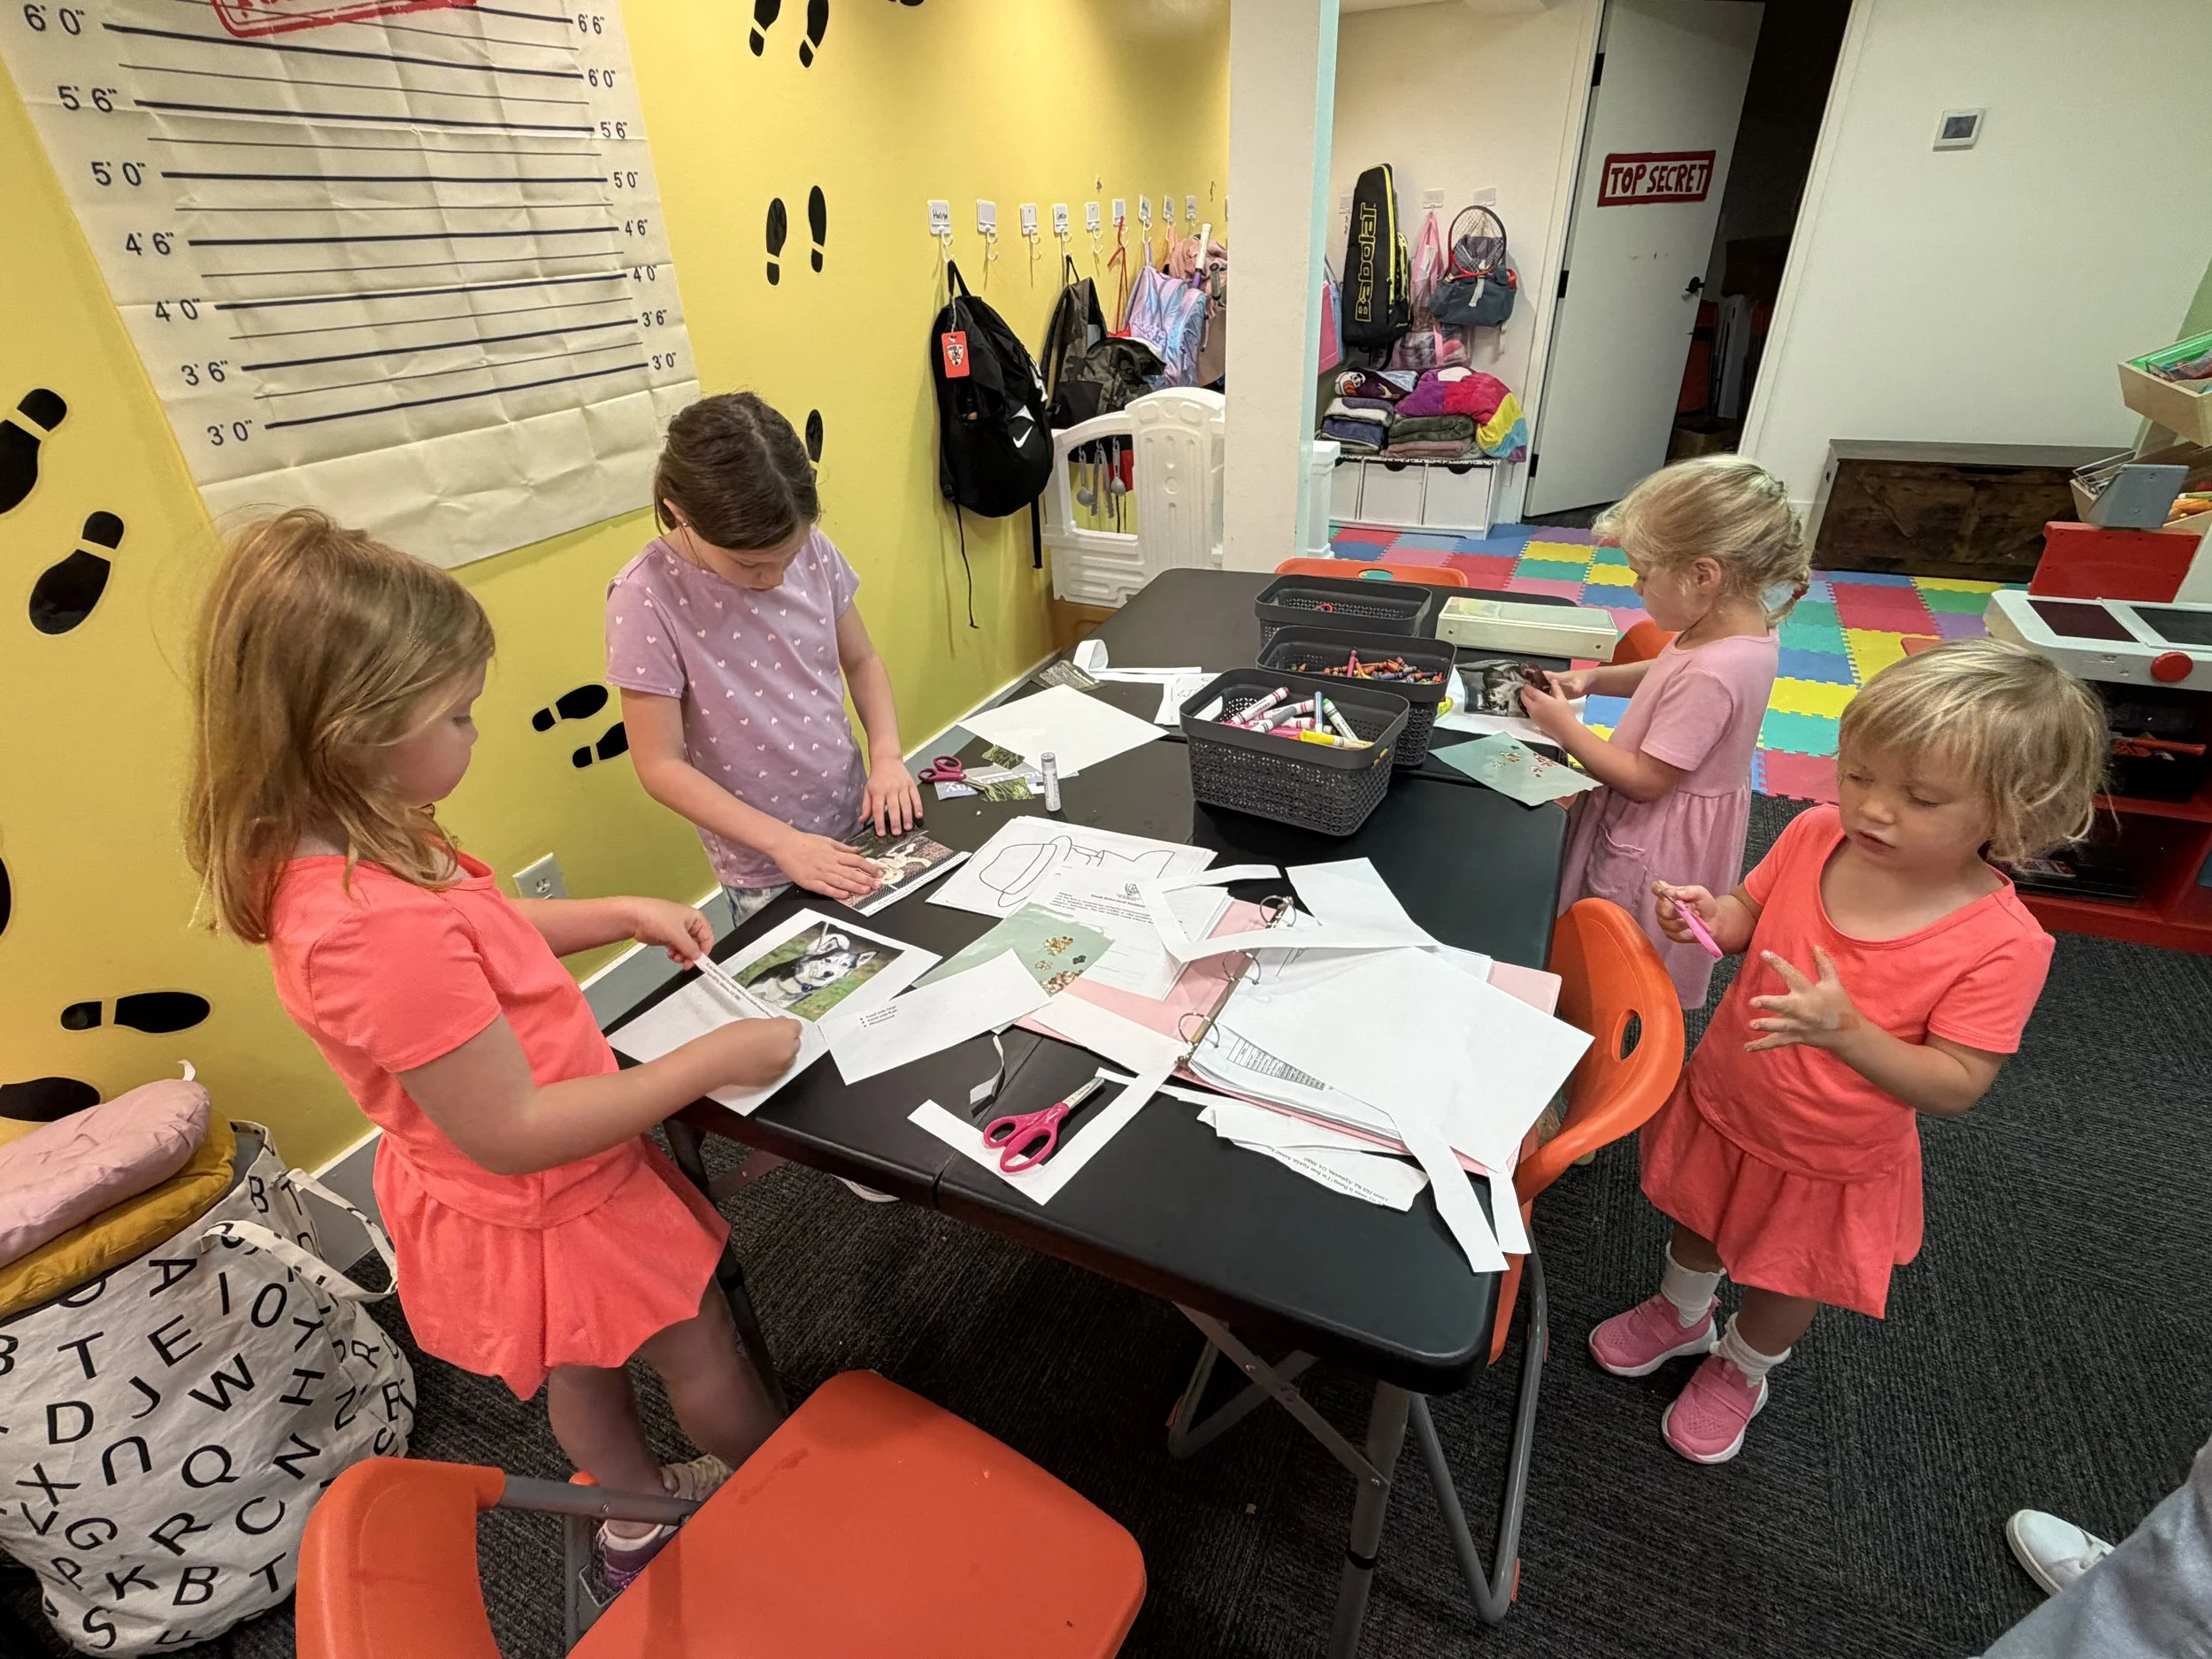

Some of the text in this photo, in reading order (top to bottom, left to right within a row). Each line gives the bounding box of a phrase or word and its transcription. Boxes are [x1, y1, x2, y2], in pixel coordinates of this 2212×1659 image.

[1610, 163, 1709, 196] TOP SECRET
[149, 1258, 198, 1298] A
[57, 1331, 104, 1380] T
[147, 1314, 204, 1368] E
[46, 1401, 95, 1445] D
[16, 1462, 82, 1507] X
[181, 1445, 241, 1489] Q
[65, 1517, 119, 1551] G
[149, 1512, 214, 1556] R
[235, 1496, 286, 1536] C
[105, 1564, 159, 1601] K
[173, 1566, 220, 1606] B
[250, 1551, 287, 1594] T
[82, 1605, 117, 1649] S
